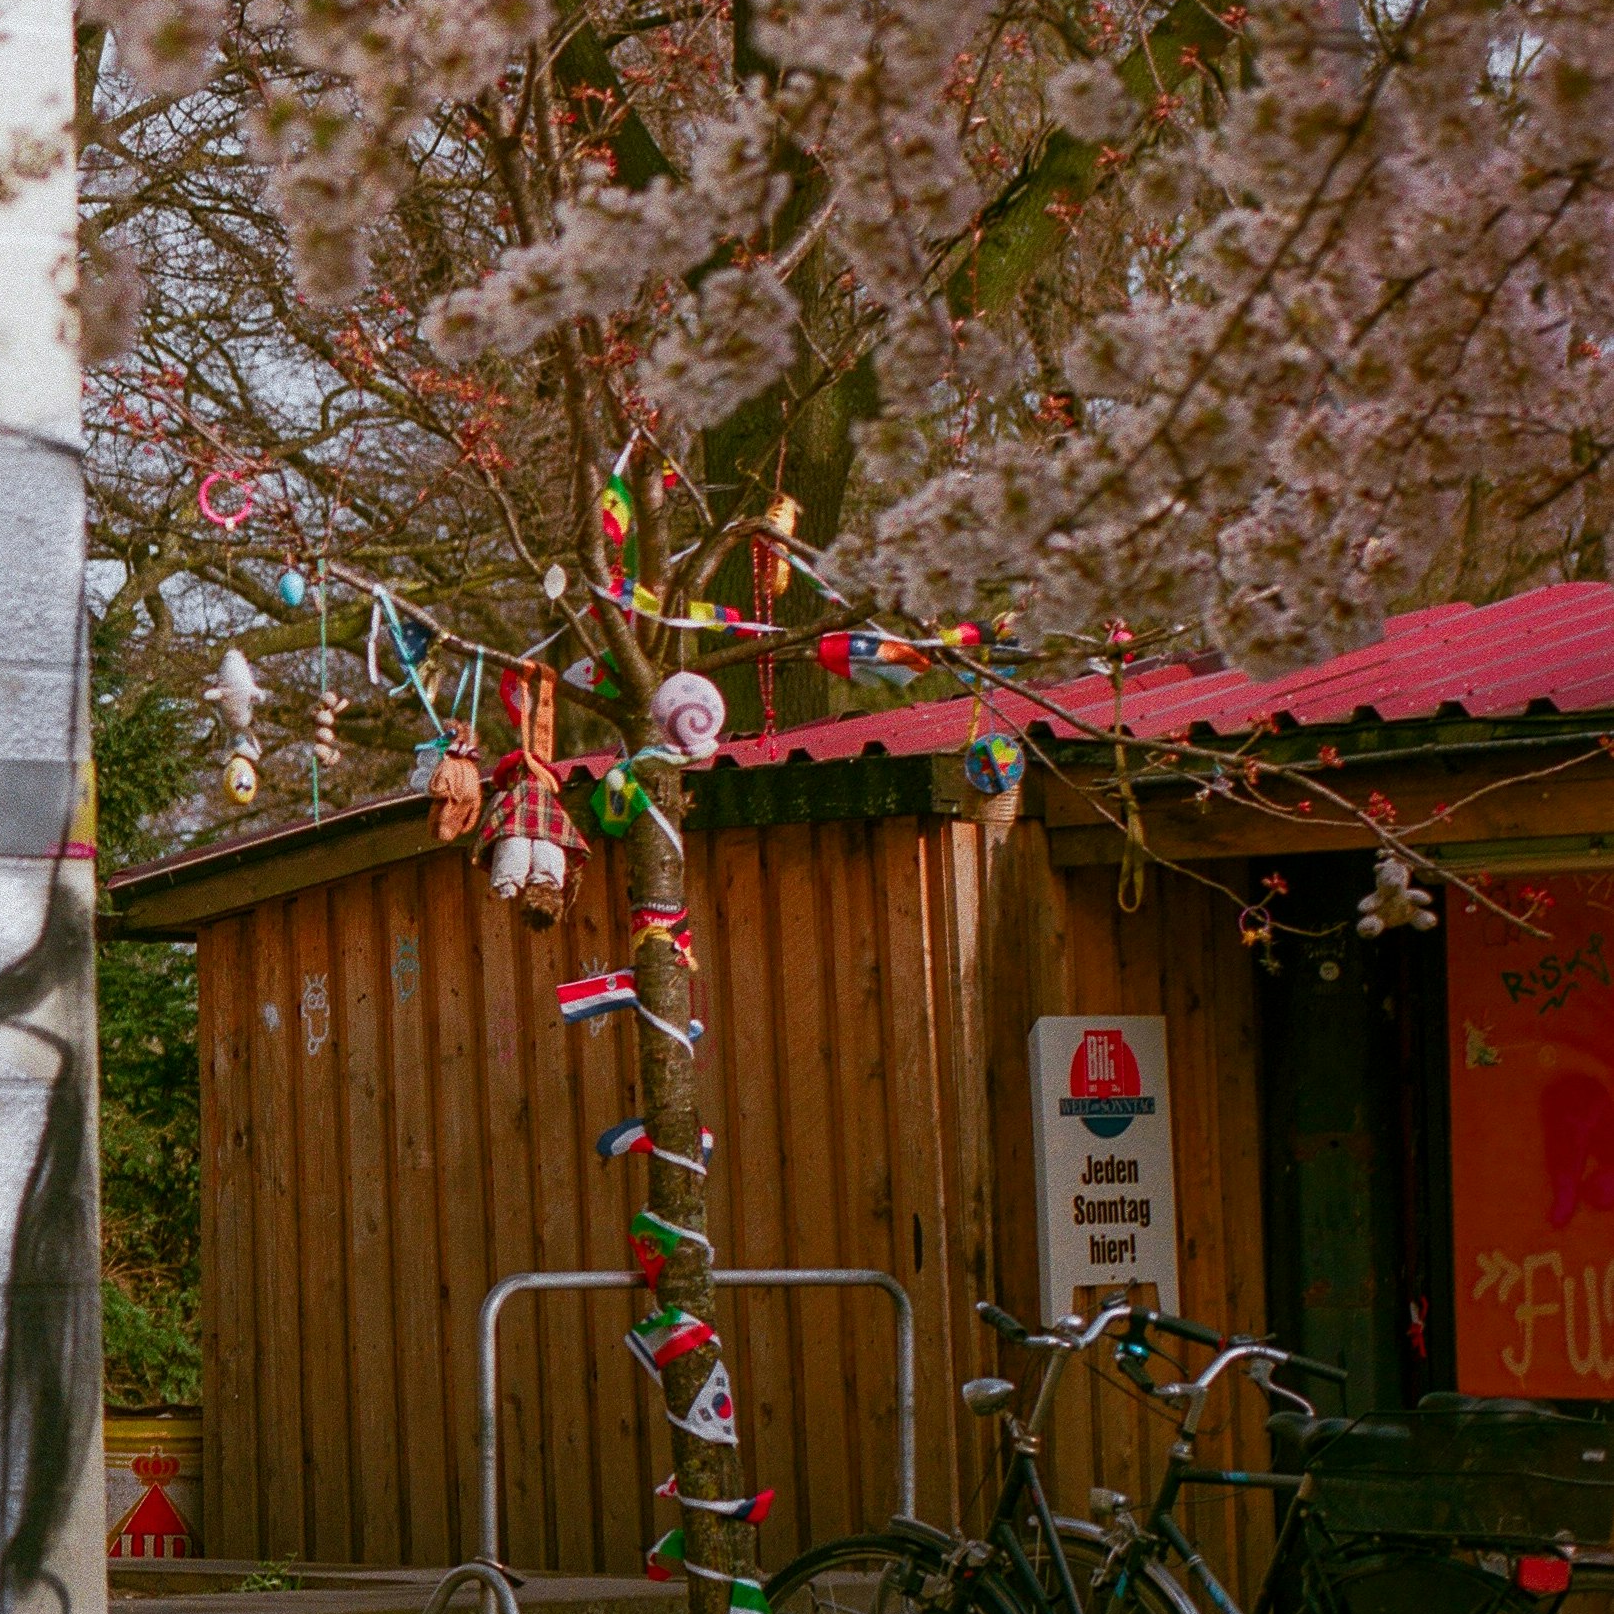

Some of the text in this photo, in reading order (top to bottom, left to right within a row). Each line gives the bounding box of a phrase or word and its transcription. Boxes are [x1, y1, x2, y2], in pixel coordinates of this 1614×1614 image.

[1081, 1153, 1139, 1185] Jeden
[1073, 1194, 1151, 1228] Sonntag
[1089, 1233, 1137, 1265] hier!
